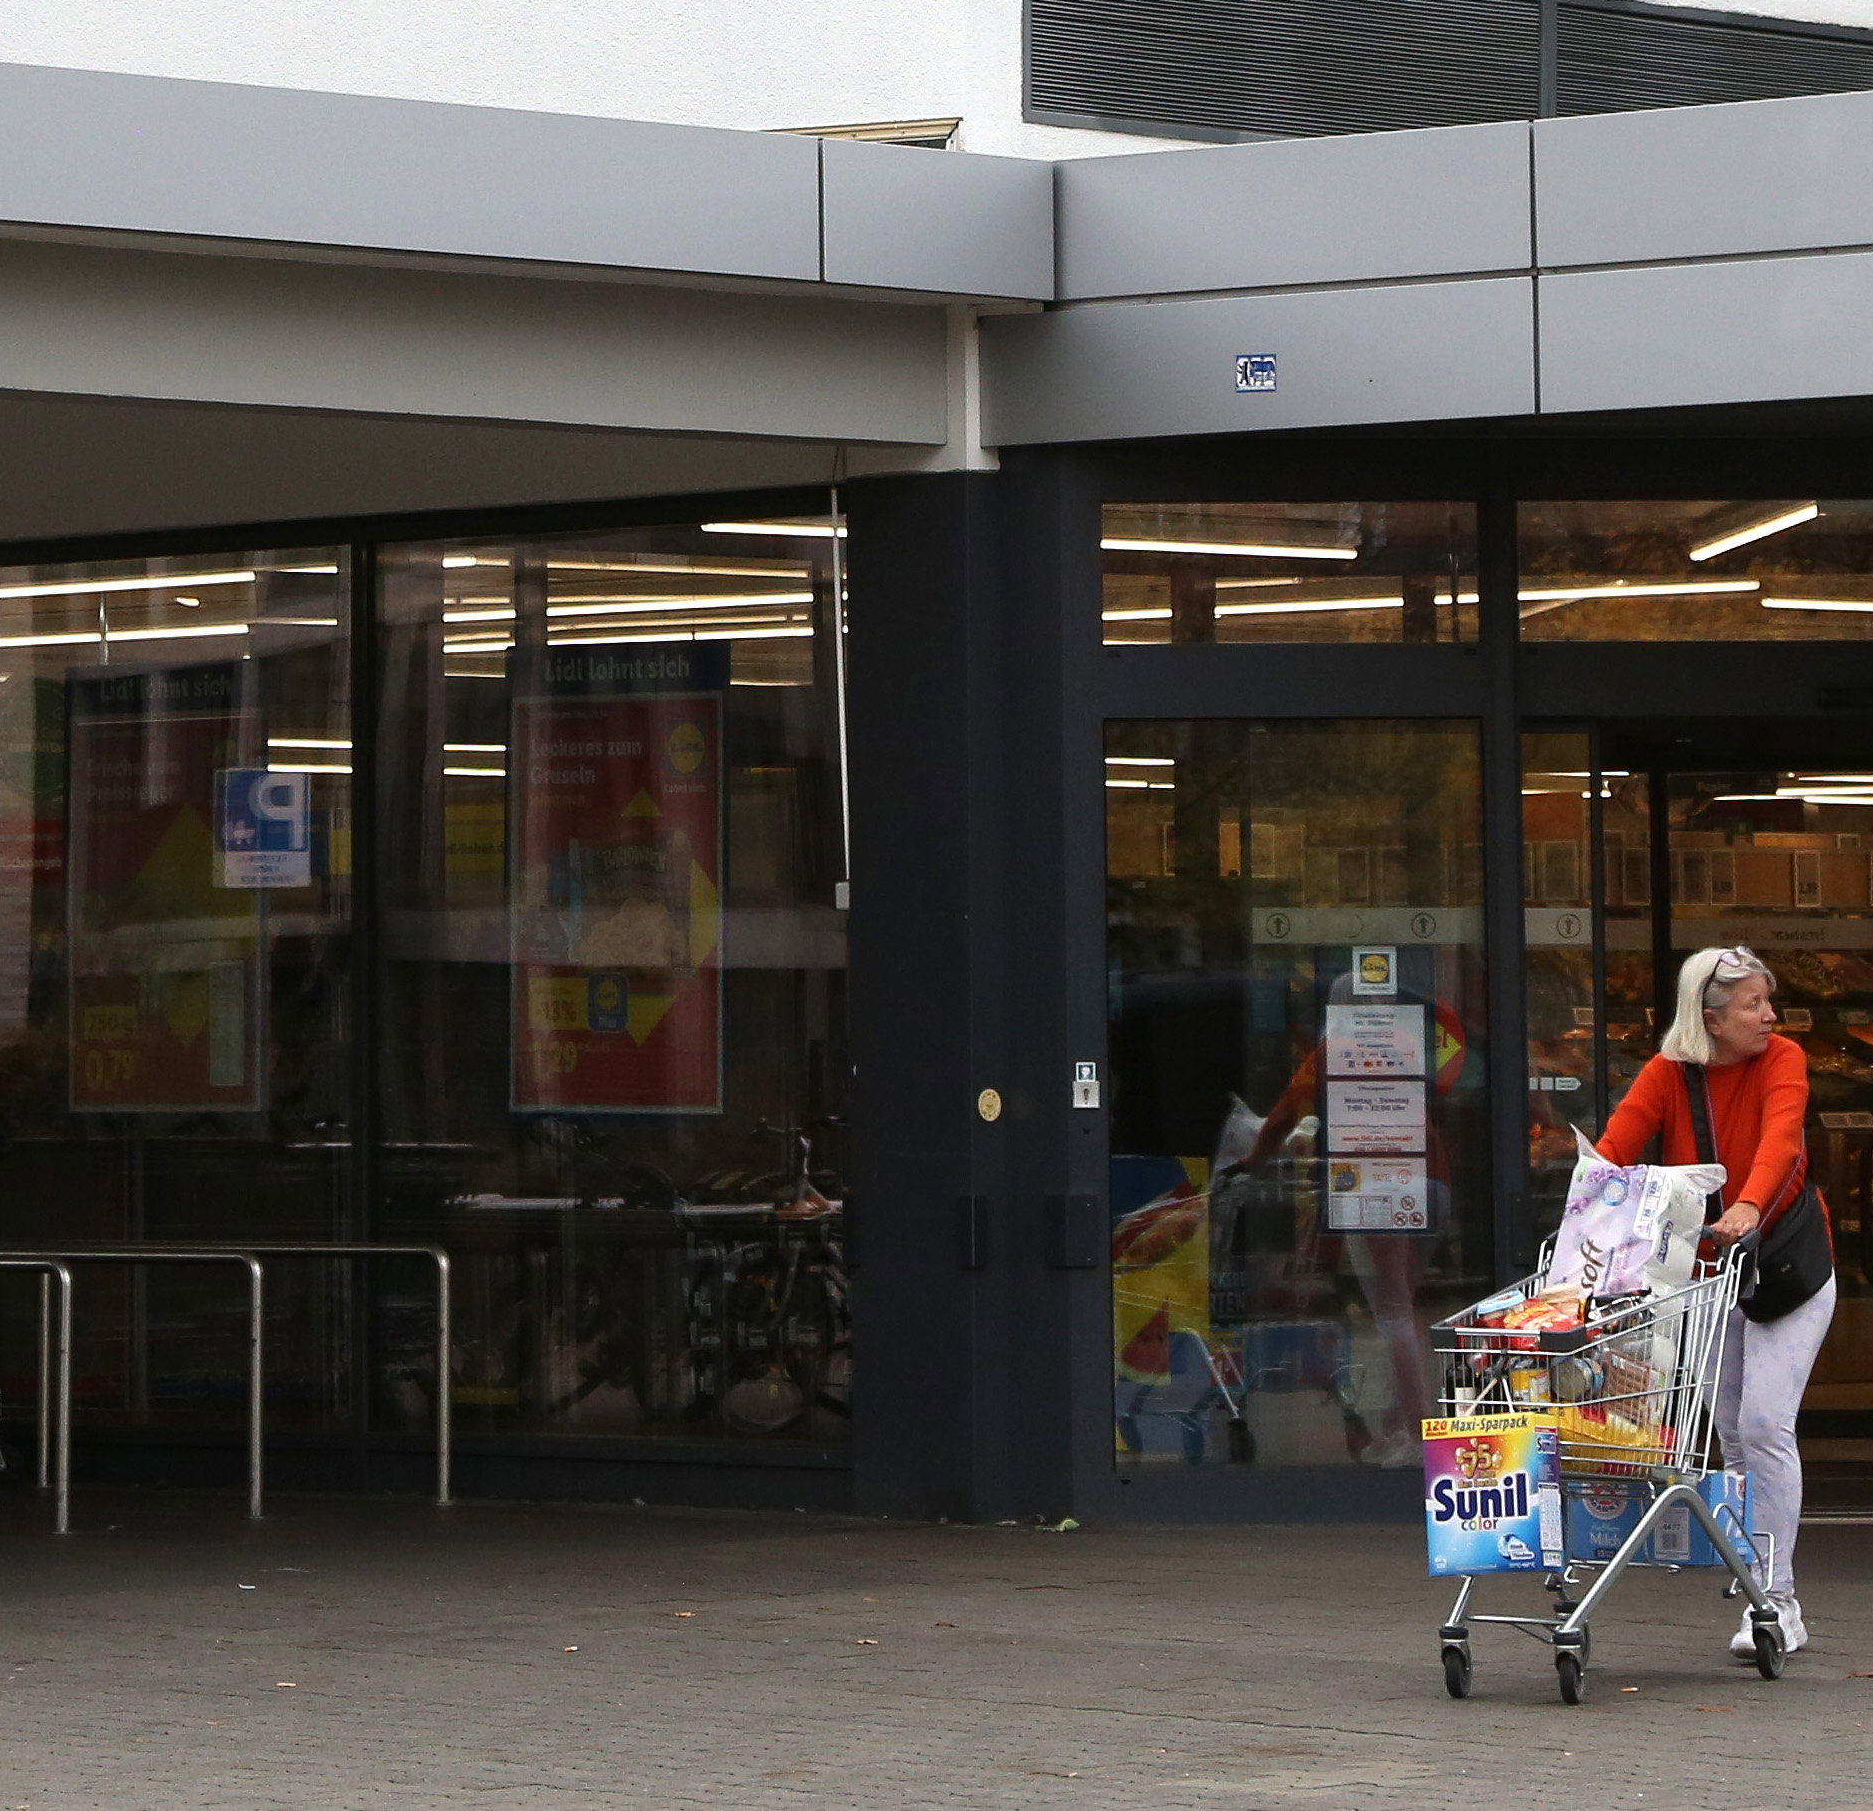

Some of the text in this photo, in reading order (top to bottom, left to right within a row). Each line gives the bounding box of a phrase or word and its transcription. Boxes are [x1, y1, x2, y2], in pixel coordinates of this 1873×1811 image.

[545, 653, 690, 682] Lidl lohnt sich
[607, 739, 642, 755] zum
[530, 765, 596, 784] Gruseln
[1426, 1415, 1528, 1433] 120 Maxi-Sparpack
[1434, 1472, 1528, 1522] Sunil
[1461, 1515, 1500, 1532] color
